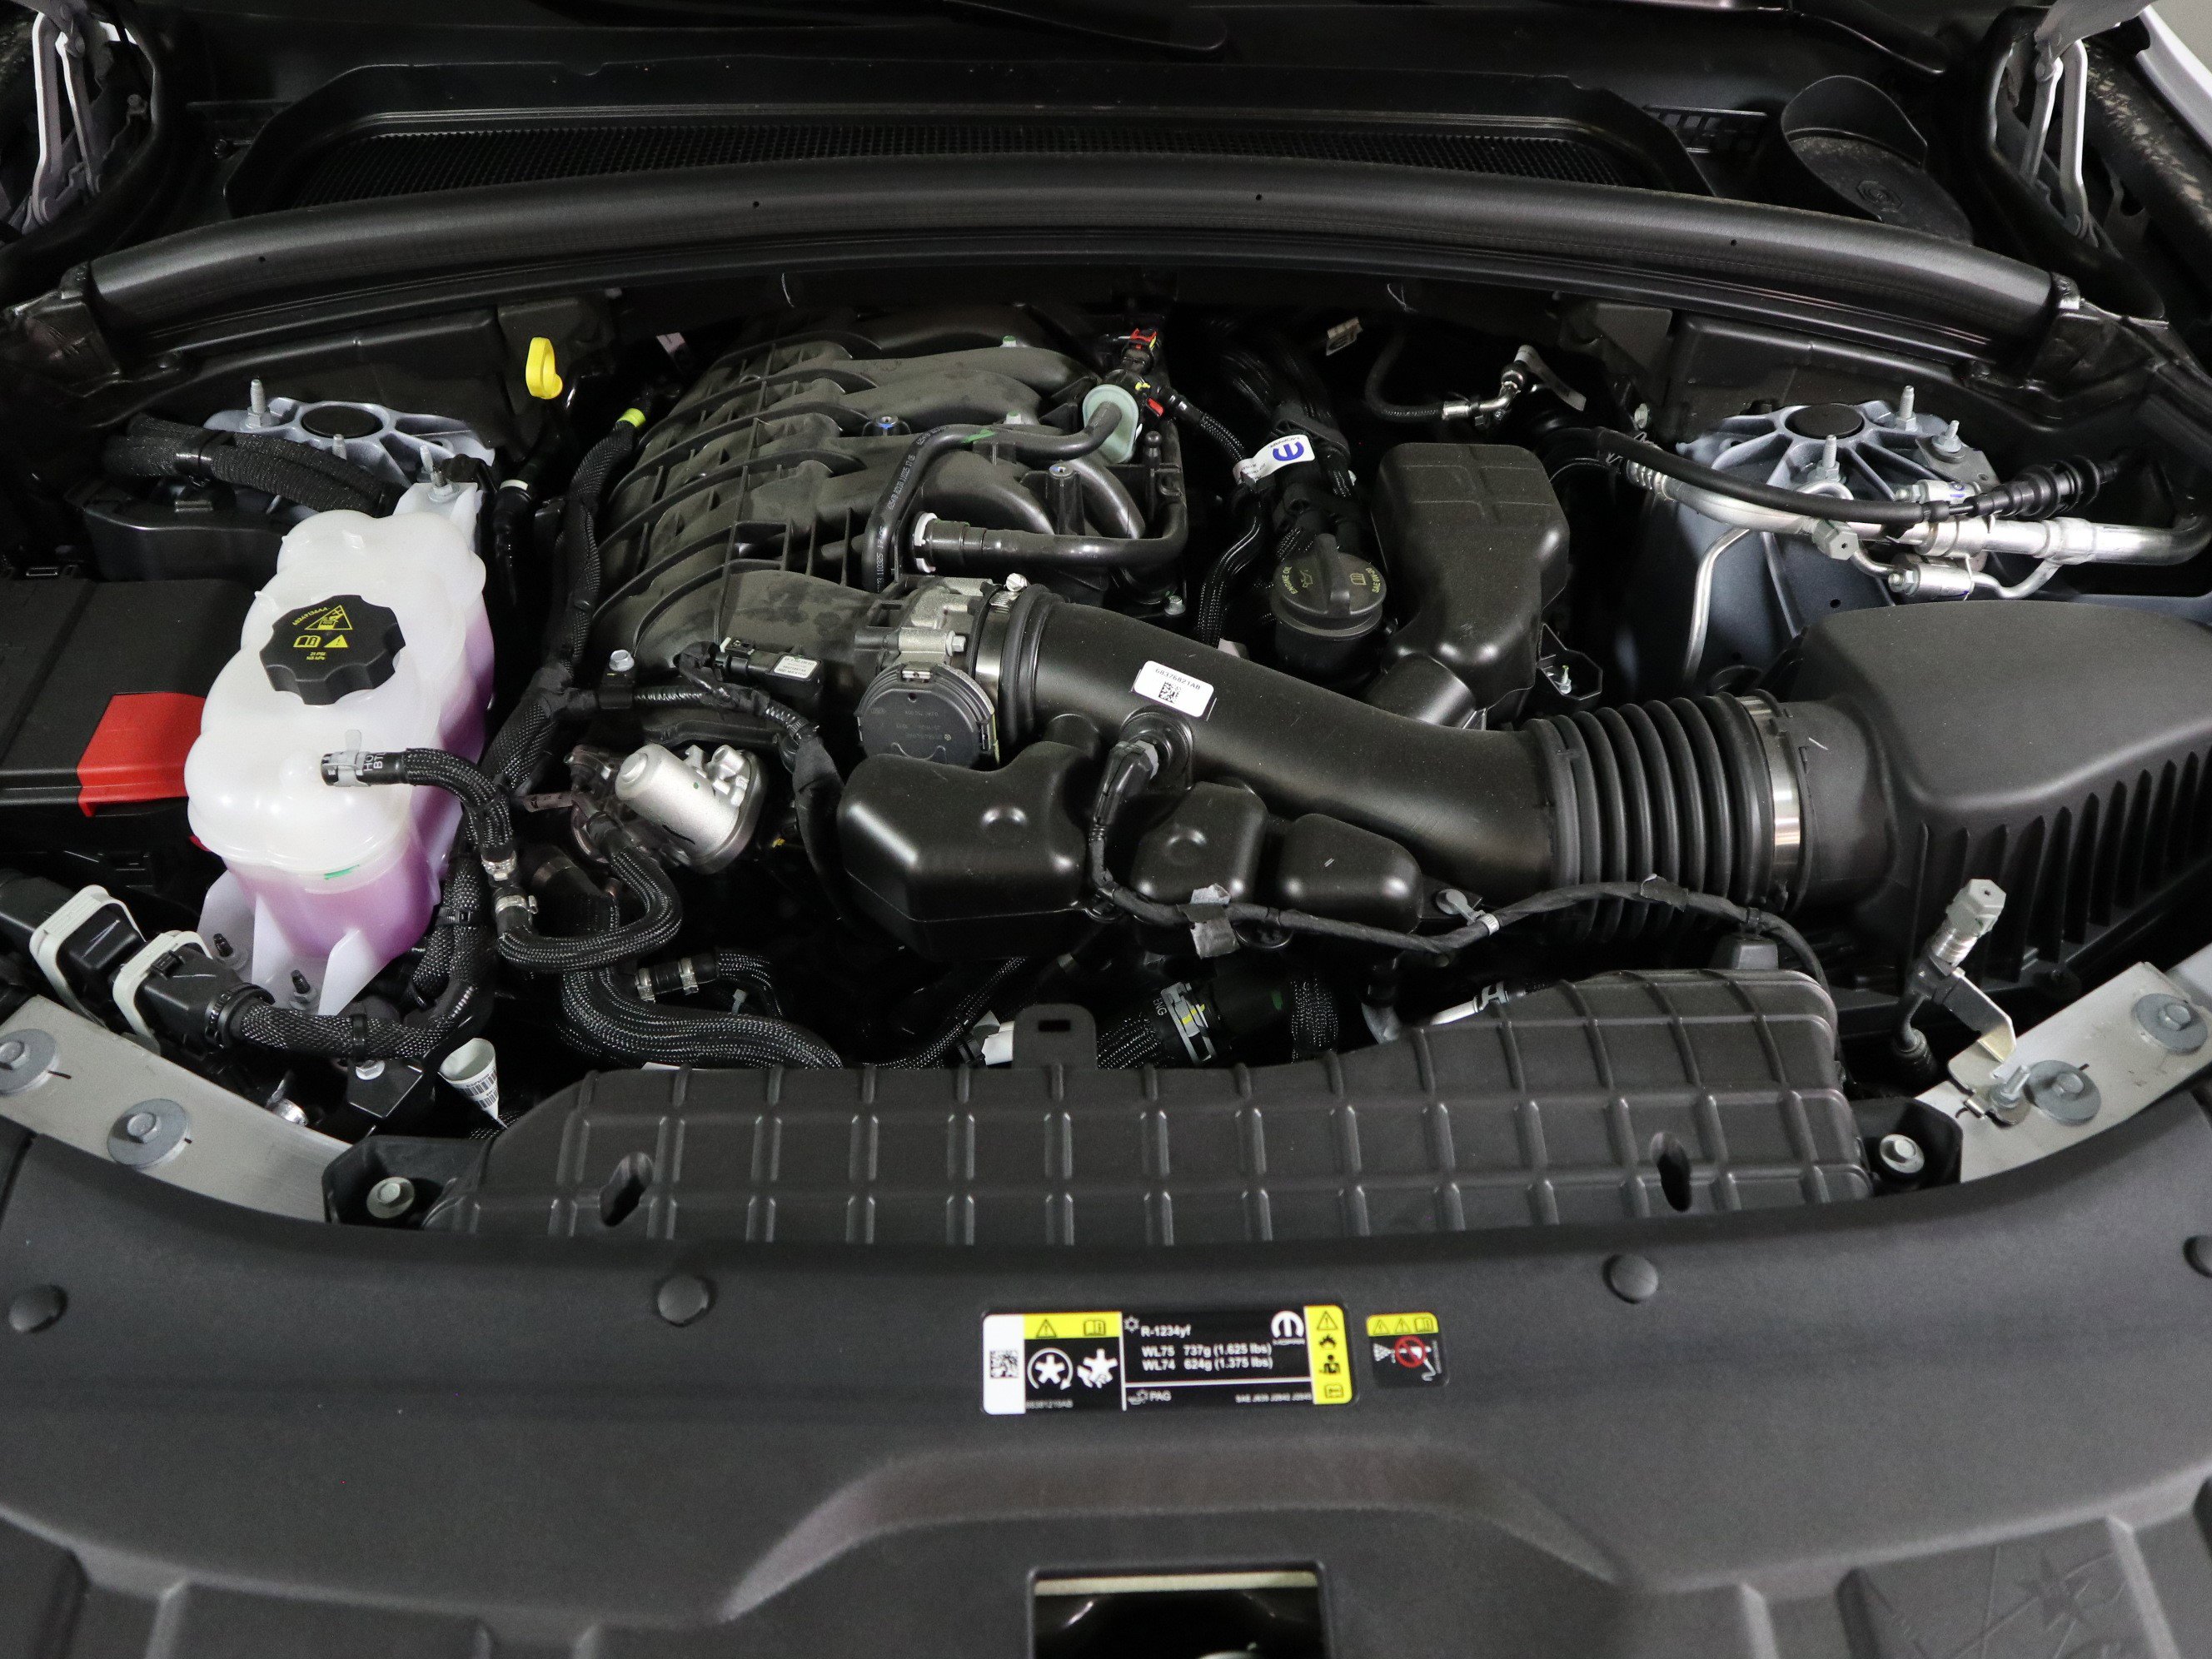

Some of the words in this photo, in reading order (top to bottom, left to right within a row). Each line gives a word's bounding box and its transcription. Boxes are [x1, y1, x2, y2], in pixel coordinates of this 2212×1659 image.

[876, 552, 884, 575] 110325
[1283, 574, 1298, 594] ENGINE
[1372, 582, 1381, 594] SAE
[1155, 668, 1201, 690] 68376821AB
[1153, 998, 1168, 1016] ENG
[1140, 1323, 1192, 1338] R-1234yf
[1141, 1345, 1175, 1358] WL75
[1183, 1343, 1212, 1358] 737g
[1213, 1343, 1248, 1358] (1.625
[1249, 1342, 1272, 1356] lbs)
[1142, 1358, 1176, 1372] WL74
[1183, 1358, 1213, 1372] 624g
[1213, 1357, 1249, 1372] (1.375
[1251, 1356, 1273, 1370] lbs)
[1148, 1391, 1172, 1402] PAG
